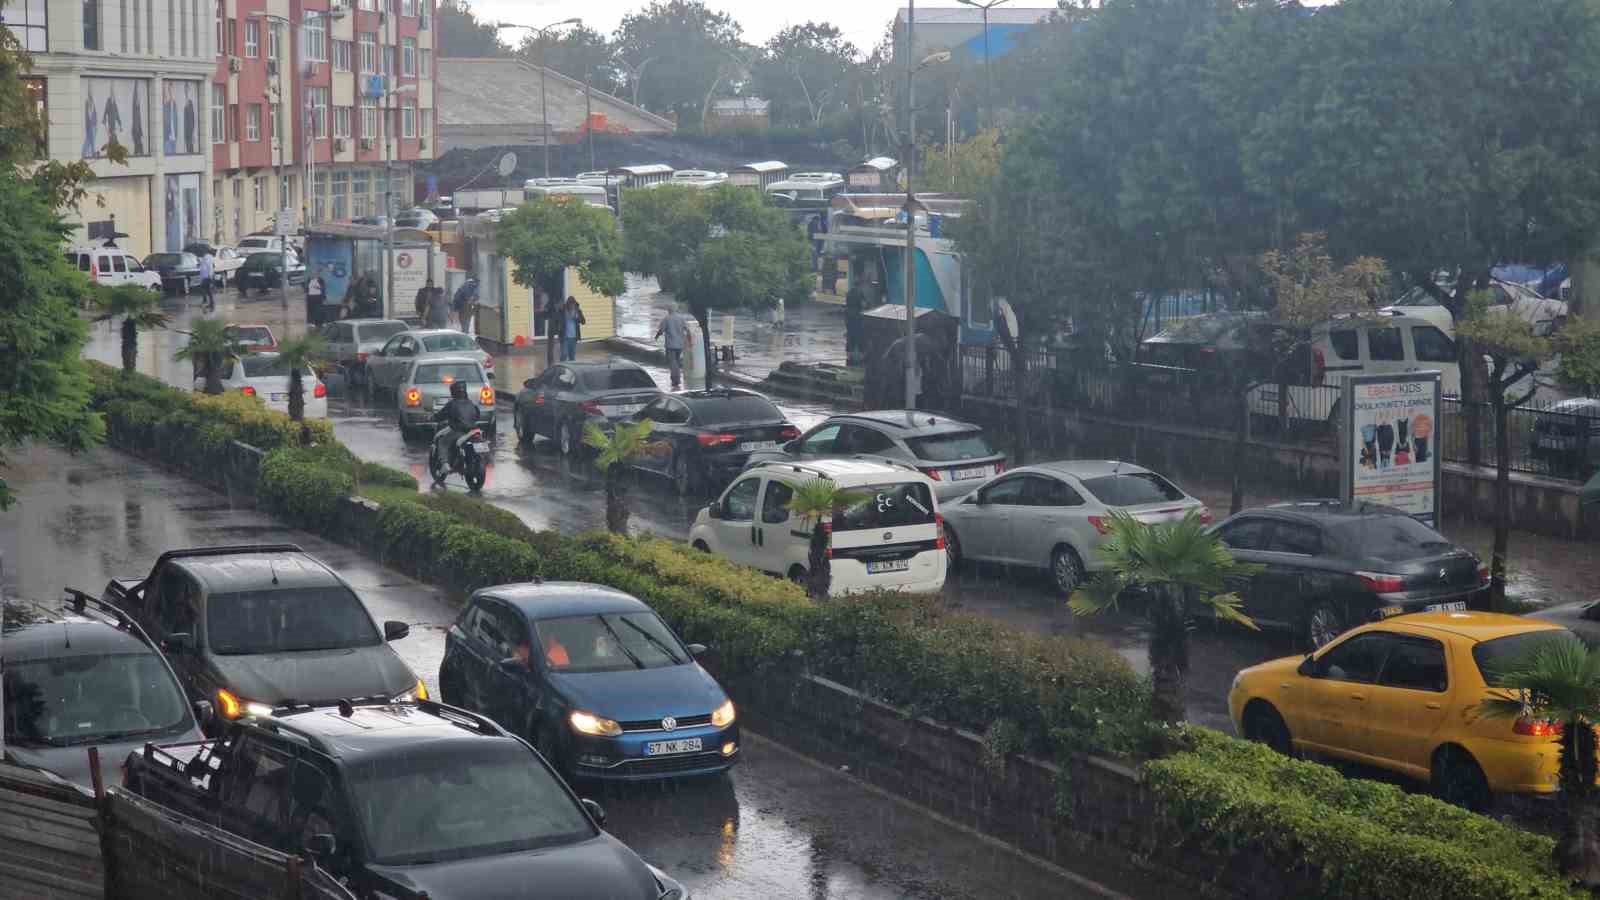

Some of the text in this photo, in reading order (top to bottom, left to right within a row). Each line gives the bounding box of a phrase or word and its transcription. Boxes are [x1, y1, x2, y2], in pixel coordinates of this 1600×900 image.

[1399, 383, 1422, 394] KIDS
[649, 738, 702, 754] 67 NK 284
